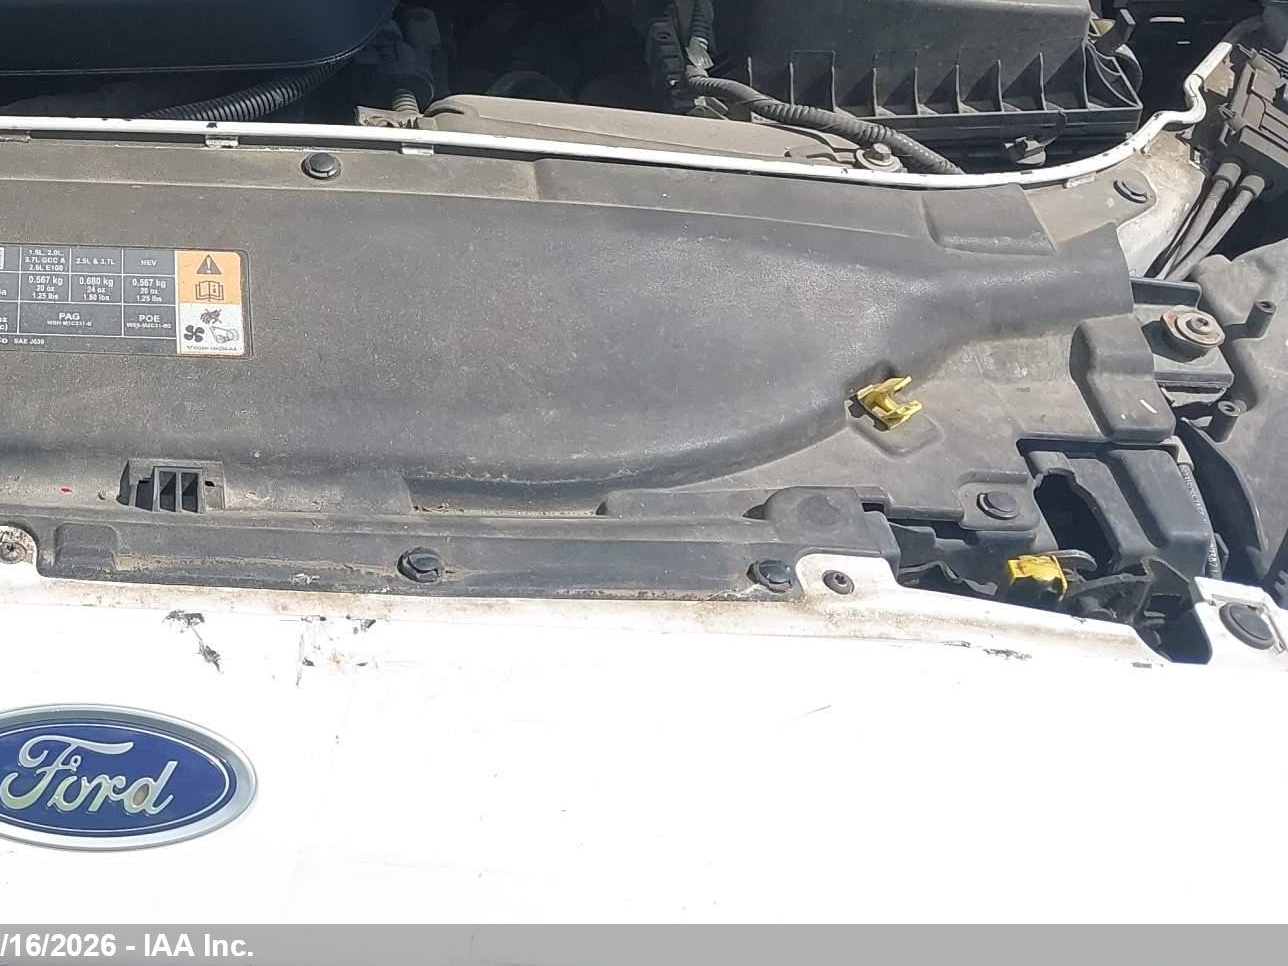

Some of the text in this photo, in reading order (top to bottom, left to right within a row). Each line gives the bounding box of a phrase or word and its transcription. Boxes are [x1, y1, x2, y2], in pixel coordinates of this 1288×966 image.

[28, 275, 63, 286] 0.567 kg
[79, 276, 114, 287] 0.680 kg
[132, 278, 166, 289] 0.567 kg
[36, 284, 44, 292] 20
[32, 292, 59, 300] 1.25 lbs
[58, 312, 81, 321] PAG
[138, 314, 161, 323] POE
[13, 337, 28, 345] SAE
